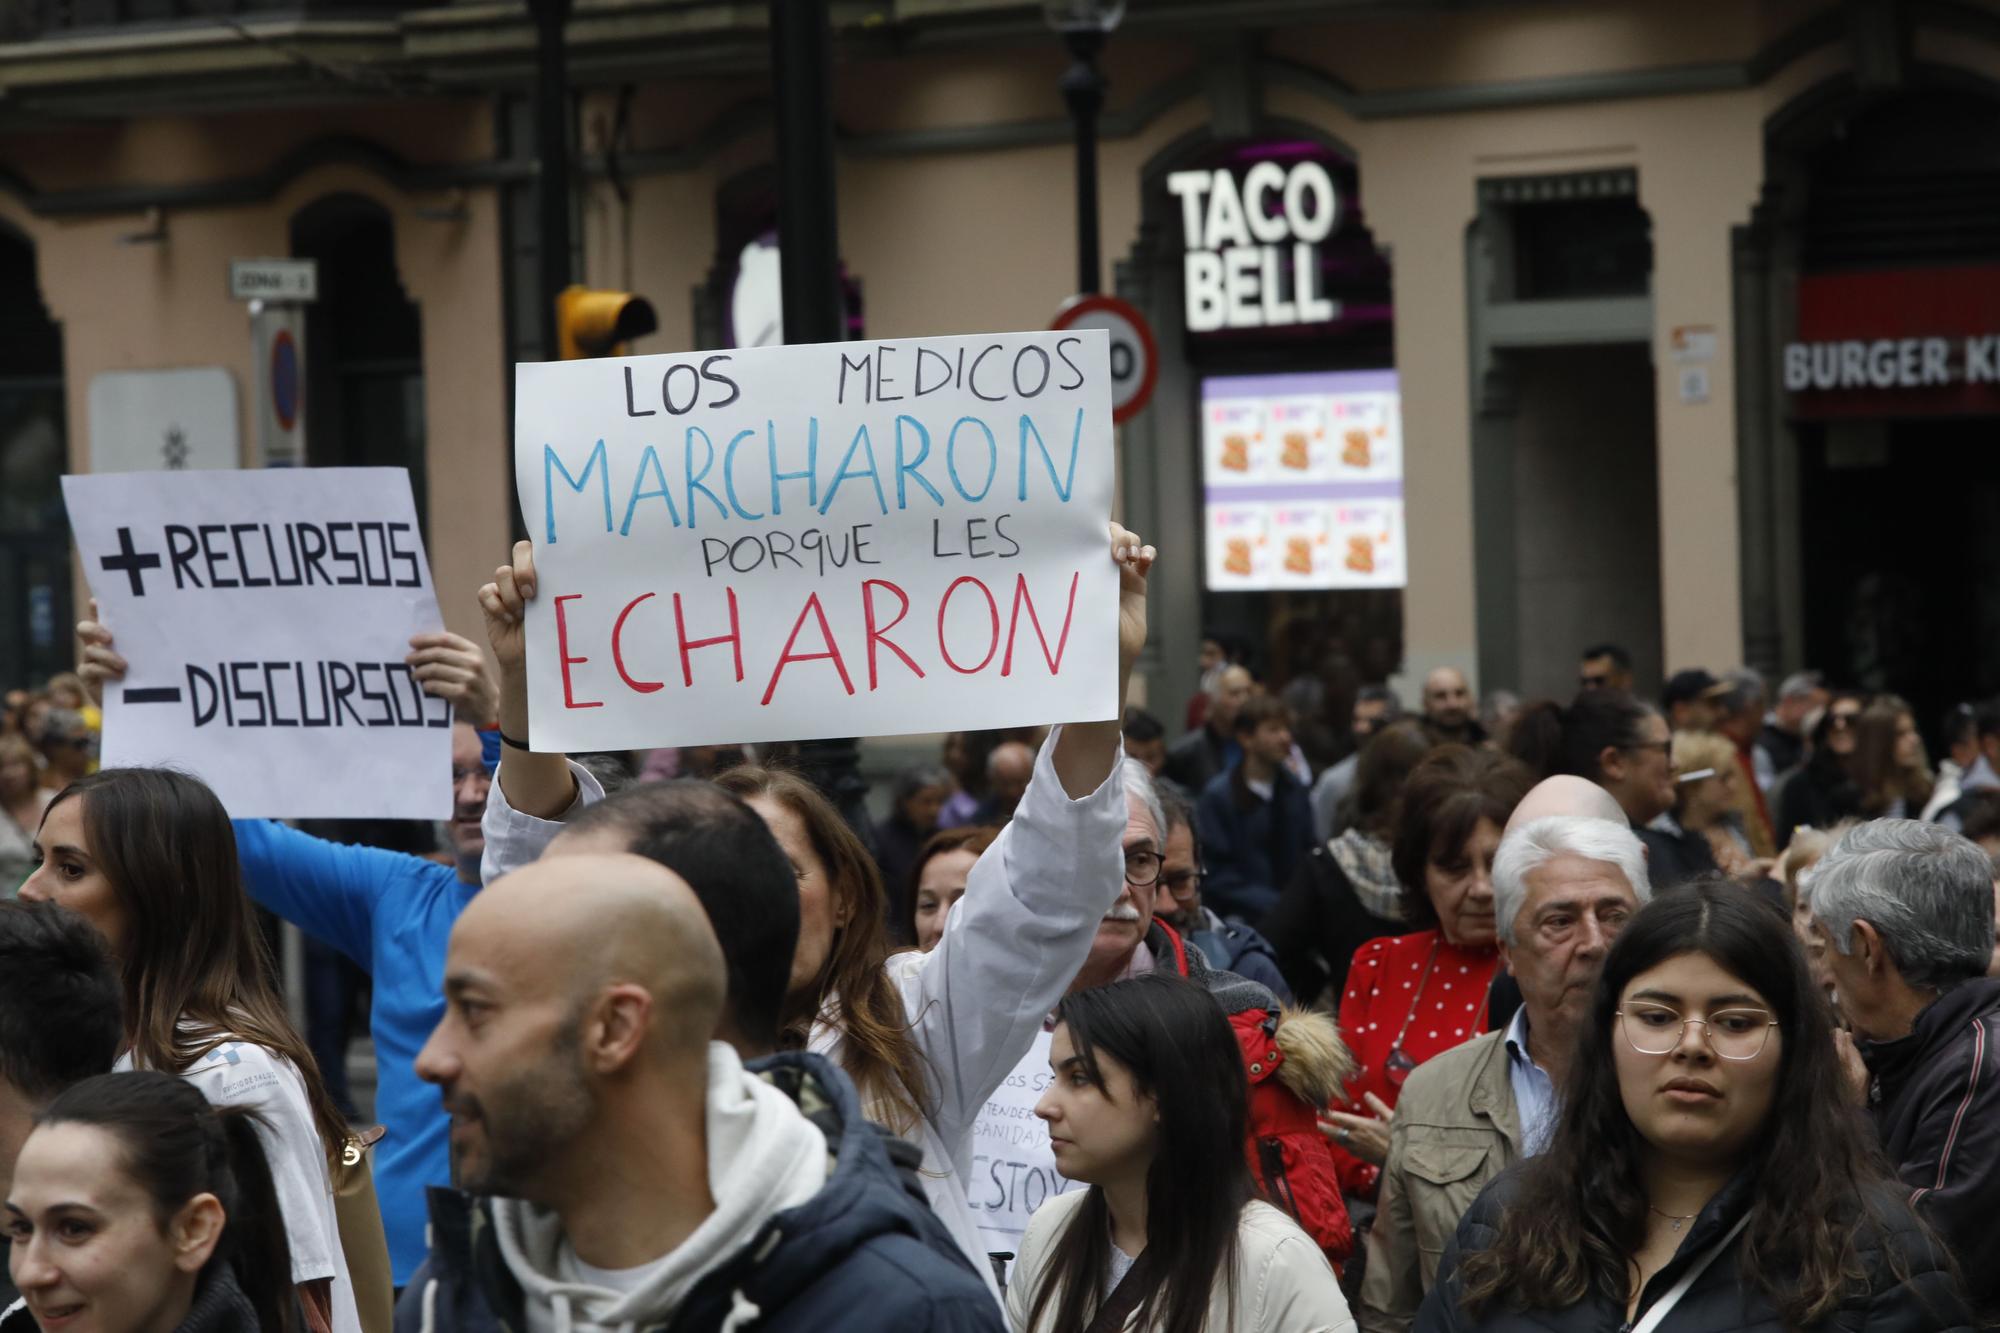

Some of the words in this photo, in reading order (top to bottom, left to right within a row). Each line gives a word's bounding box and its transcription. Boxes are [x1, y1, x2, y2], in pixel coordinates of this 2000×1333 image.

[1167, 160, 1336, 250] TACO
[1184, 242, 1335, 332] BELL
[623, 355, 741, 418] LOS
[838, 337, 1085, 405] MEDICOS
[1784, 336, 1951, 391] BURGER
[544, 407, 1085, 545] MARCHARON
[933, 513, 1021, 560] LES
[554, 571, 1080, 709] ECHARON
